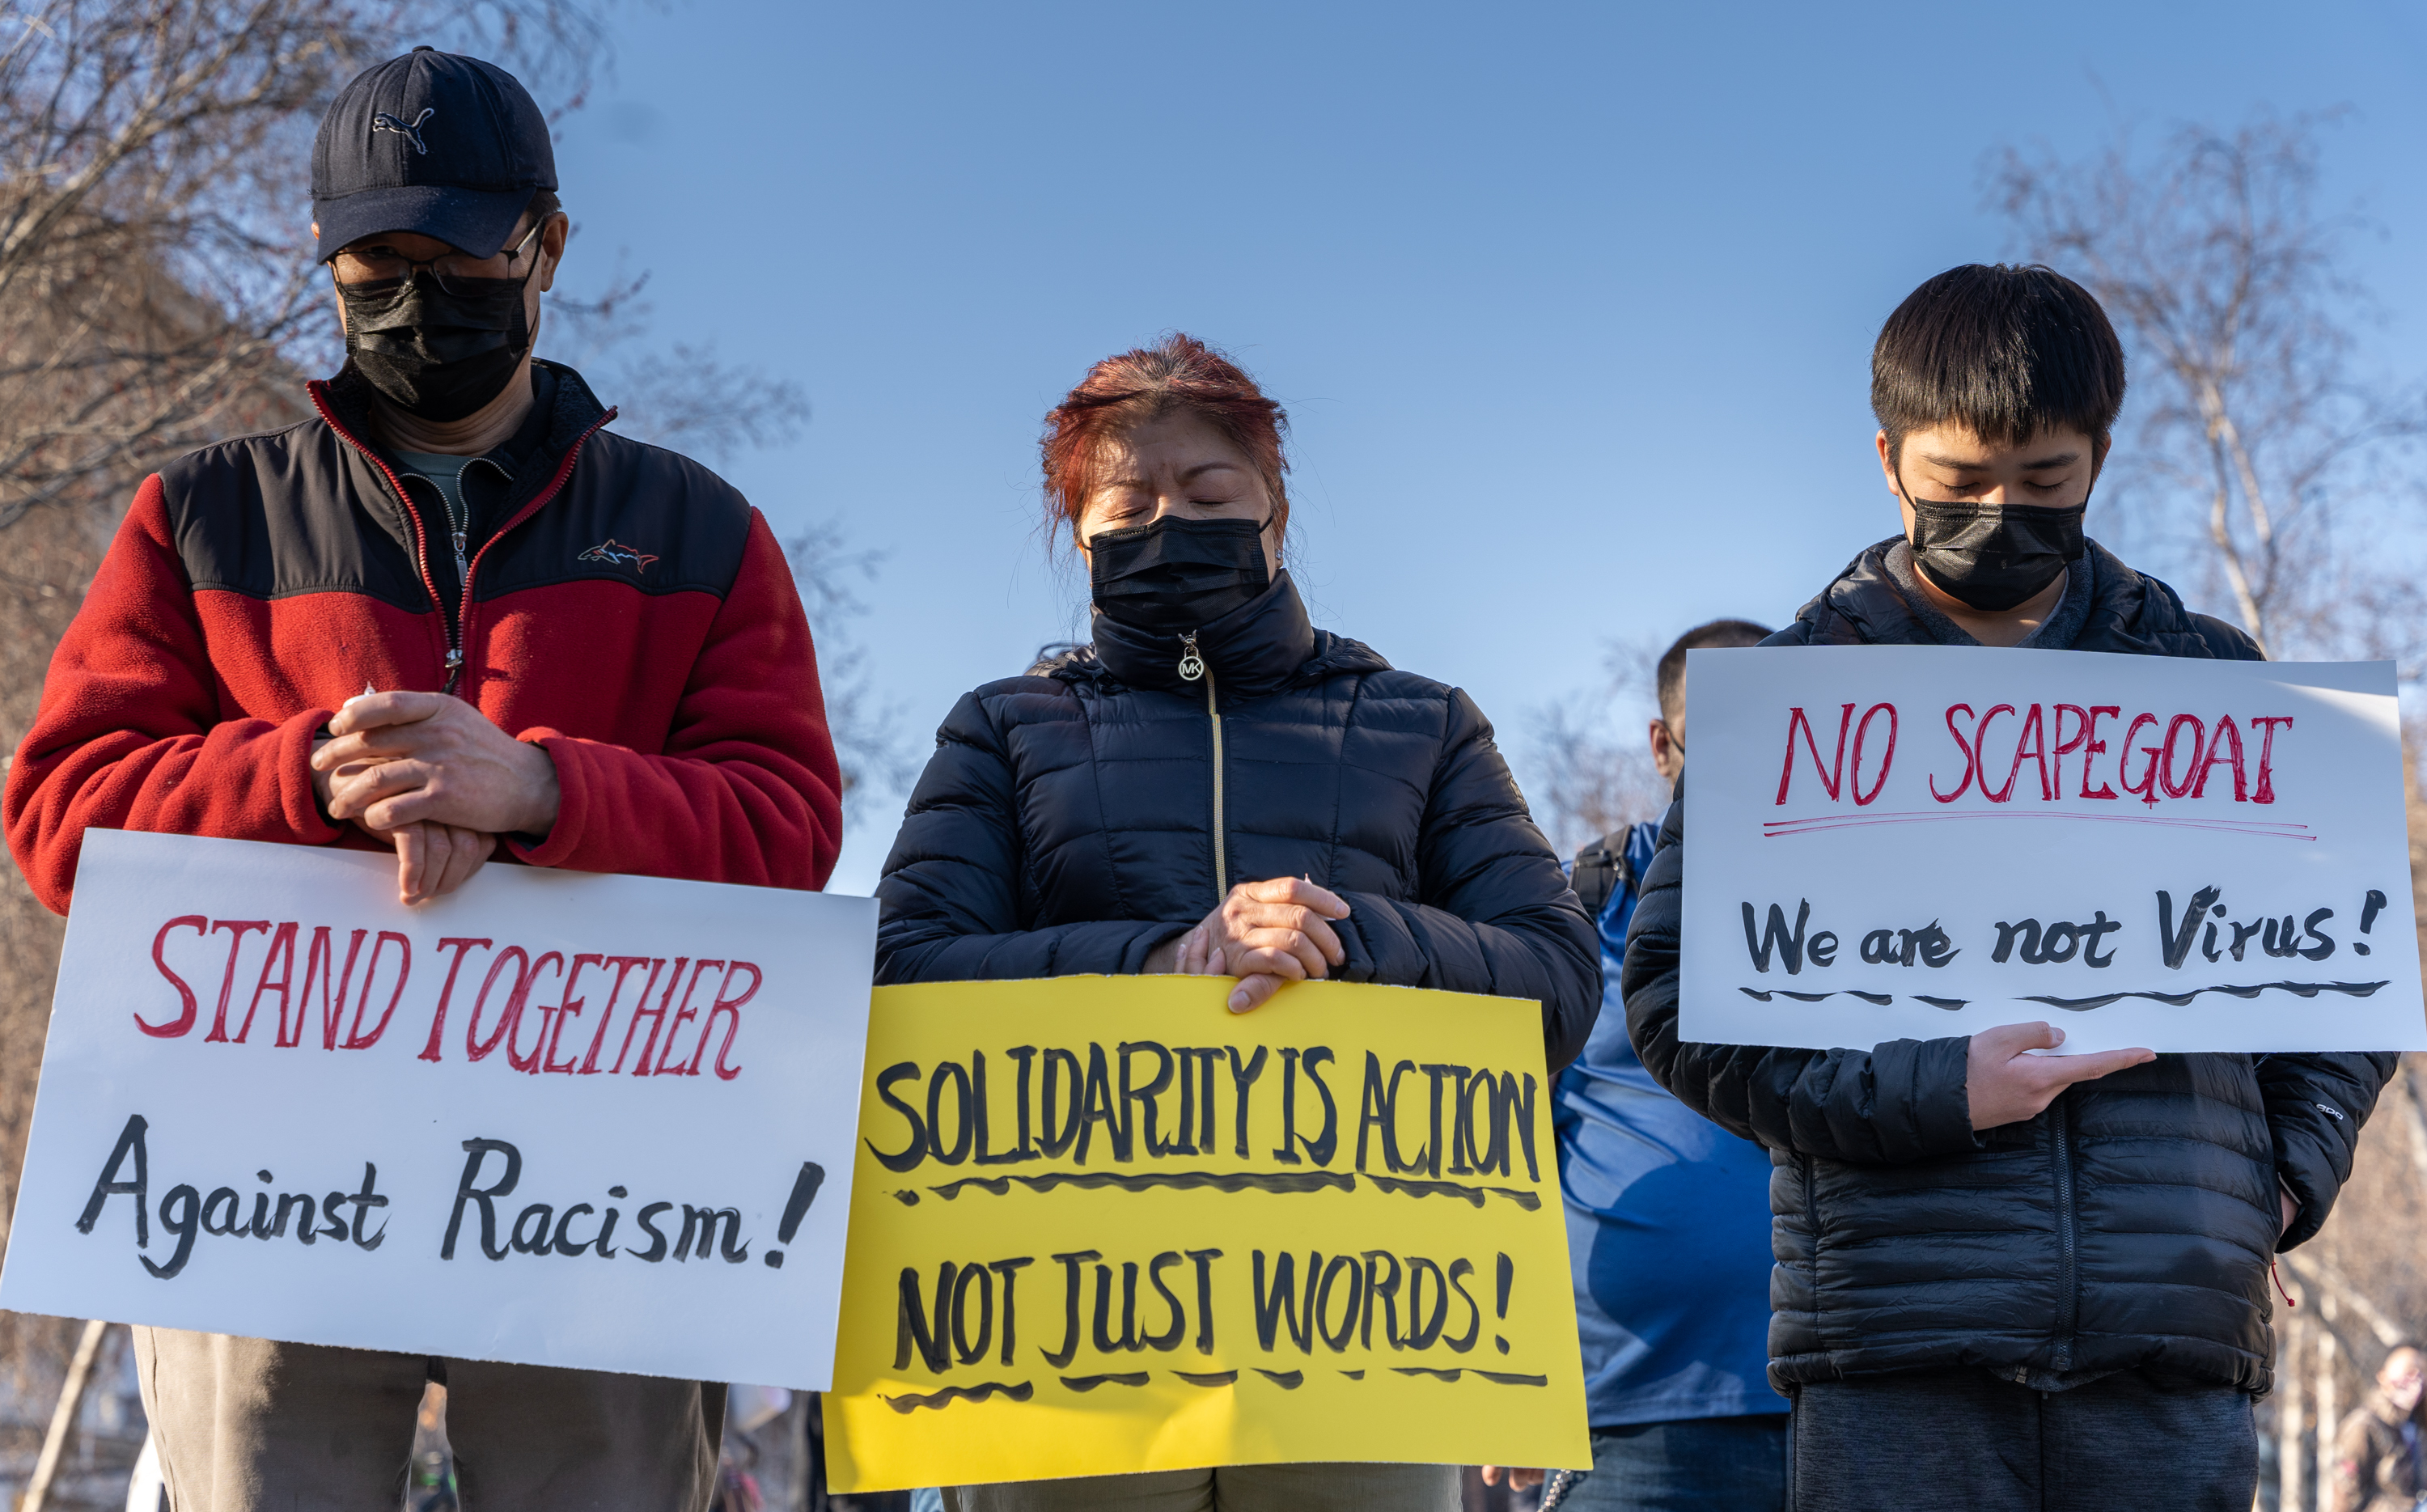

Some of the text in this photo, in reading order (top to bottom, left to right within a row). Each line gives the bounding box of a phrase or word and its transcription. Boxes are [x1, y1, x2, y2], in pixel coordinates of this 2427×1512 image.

[1181, 660, 1202, 676] MK
[1775, 702, 2294, 809] NO SCAPEGOAT
[1741, 884, 2387, 975] We are not Virus!
[134, 914, 763, 1081] STAND TOGETHER
[865, 1041, 1541, 1183] SOLIDARITY IS ACTION
[75, 1113, 826, 1280] Against Racism!
[893, 1248, 1514, 1374] NOT JUST WORDS!
